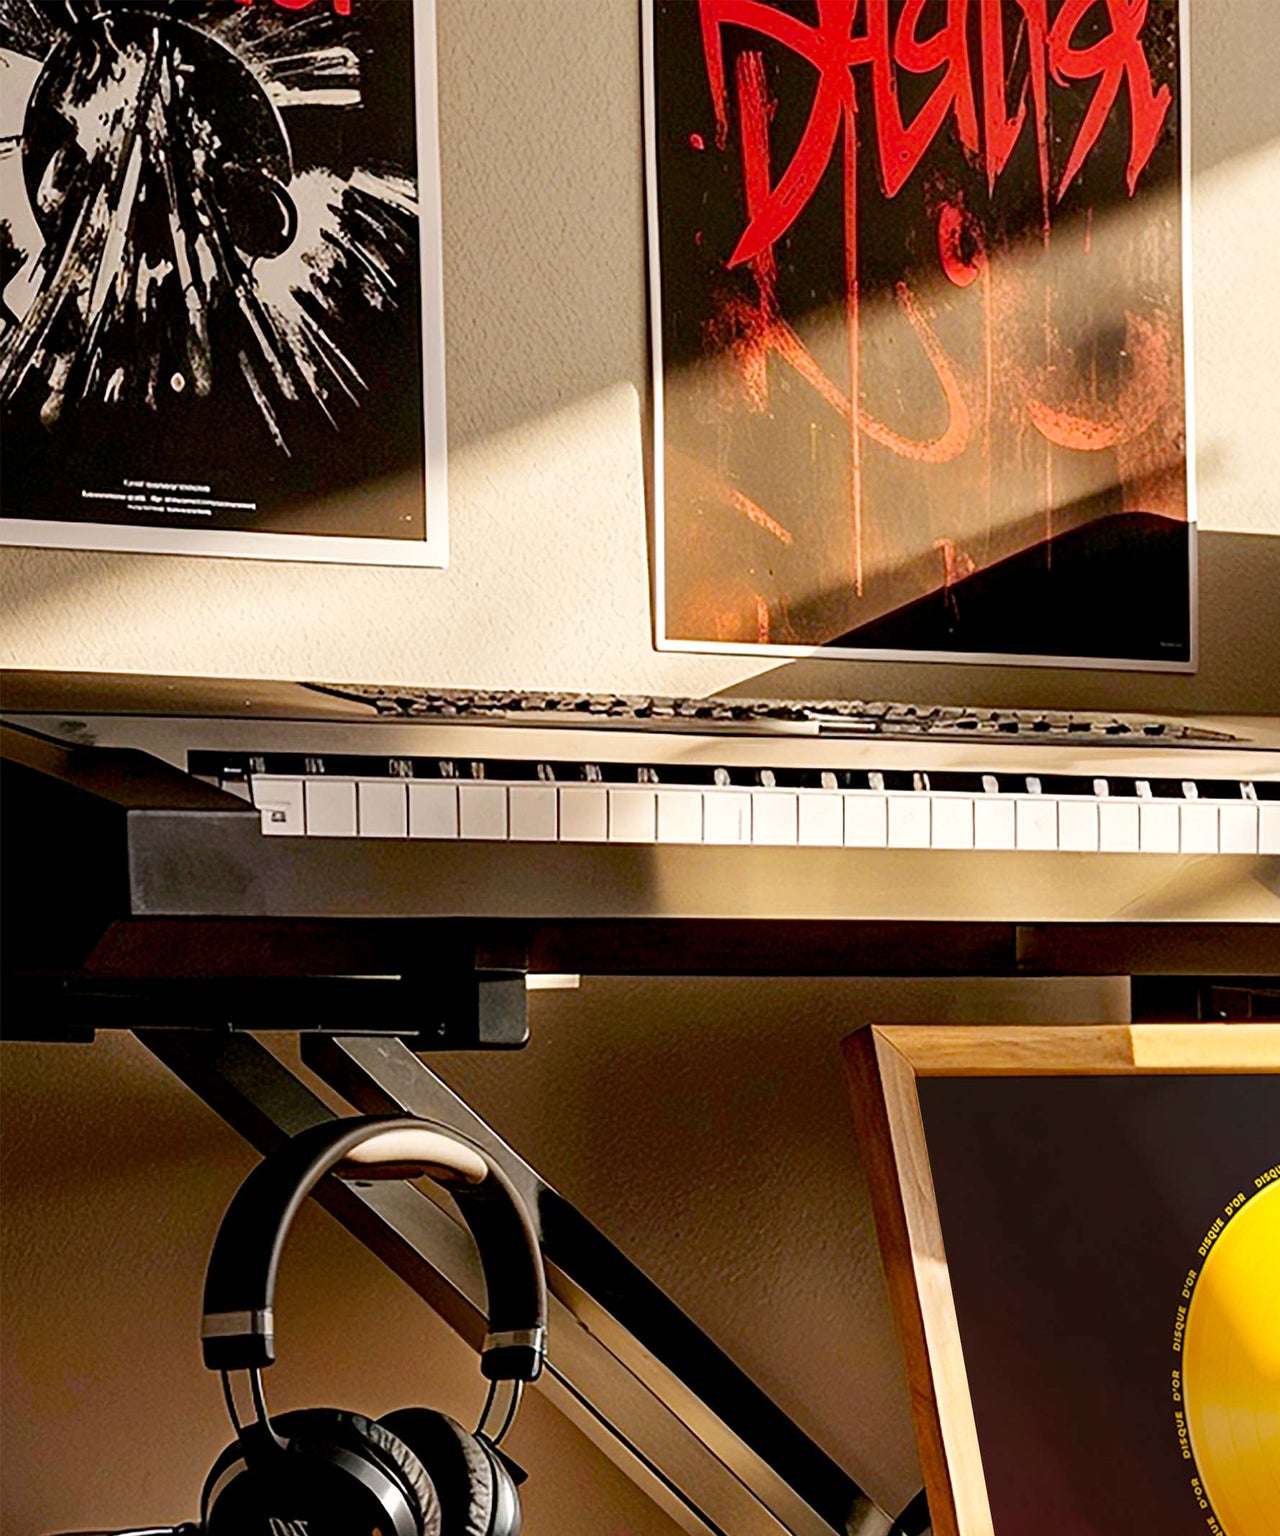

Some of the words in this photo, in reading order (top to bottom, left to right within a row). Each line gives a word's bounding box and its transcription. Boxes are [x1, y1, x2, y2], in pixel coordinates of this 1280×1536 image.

[1197, 1217, 1225, 1257] DISQUE
[1224, 1192, 1247, 1217] D'OR
[1172, 1305, 1187, 1352] DISQUE
[1181, 1269, 1197, 1299] D'OR
[1171, 1370, 1181, 1402] D'OR
[1174, 1411, 1191, 1460] DISQUE
[1190, 1477, 1208, 1509] D'OR
